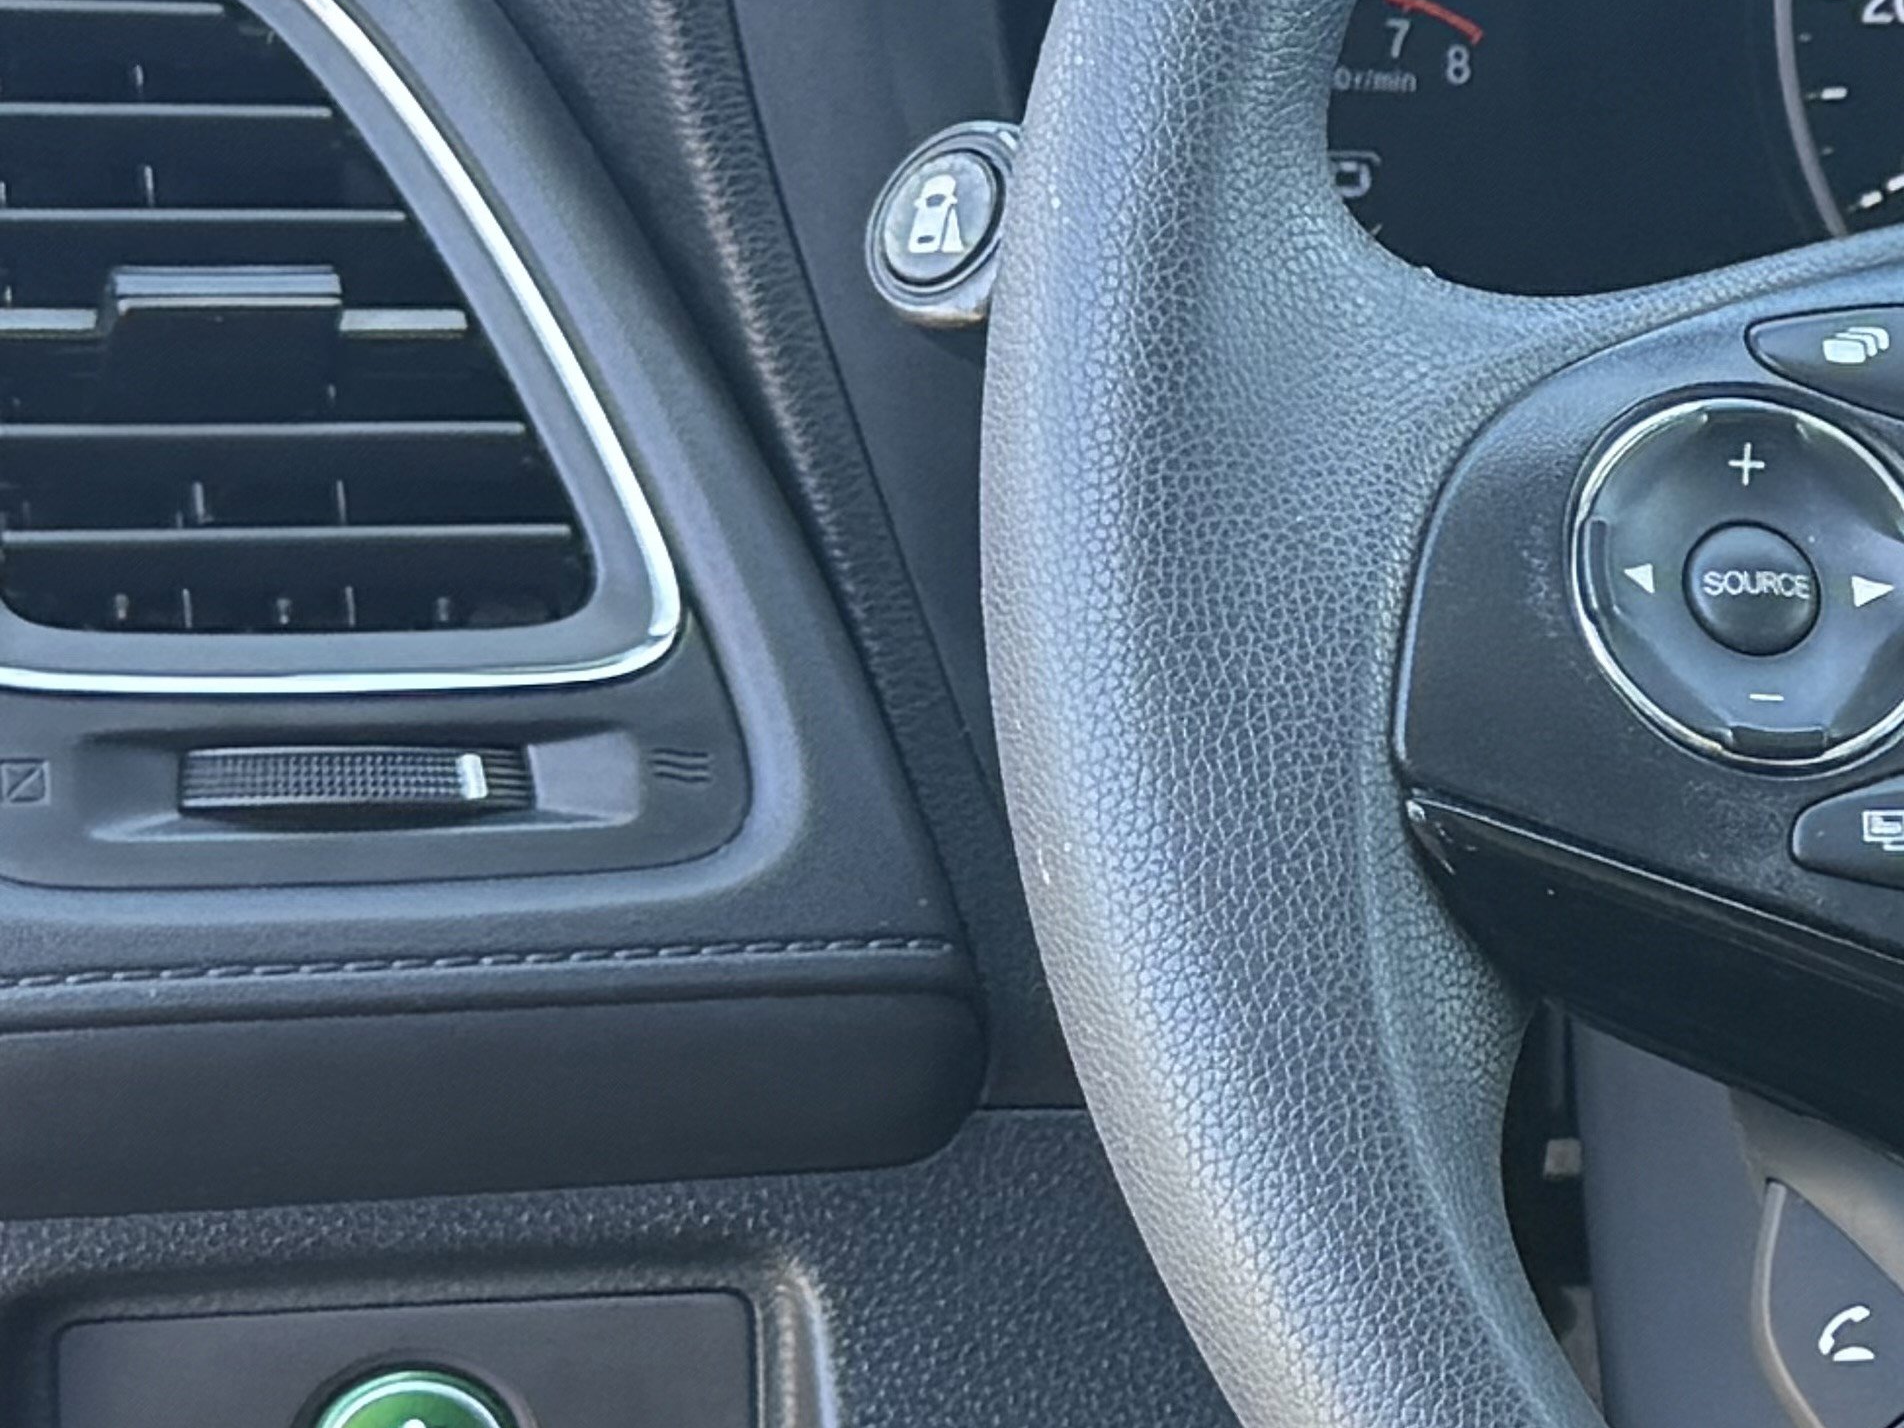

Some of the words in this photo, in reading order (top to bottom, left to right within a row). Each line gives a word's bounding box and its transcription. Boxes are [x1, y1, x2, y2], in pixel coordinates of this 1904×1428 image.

[1385, 18, 1411, 59] 7
[1446, 45, 1471, 86] 8
[1702, 569, 1811, 602] SOURCE
